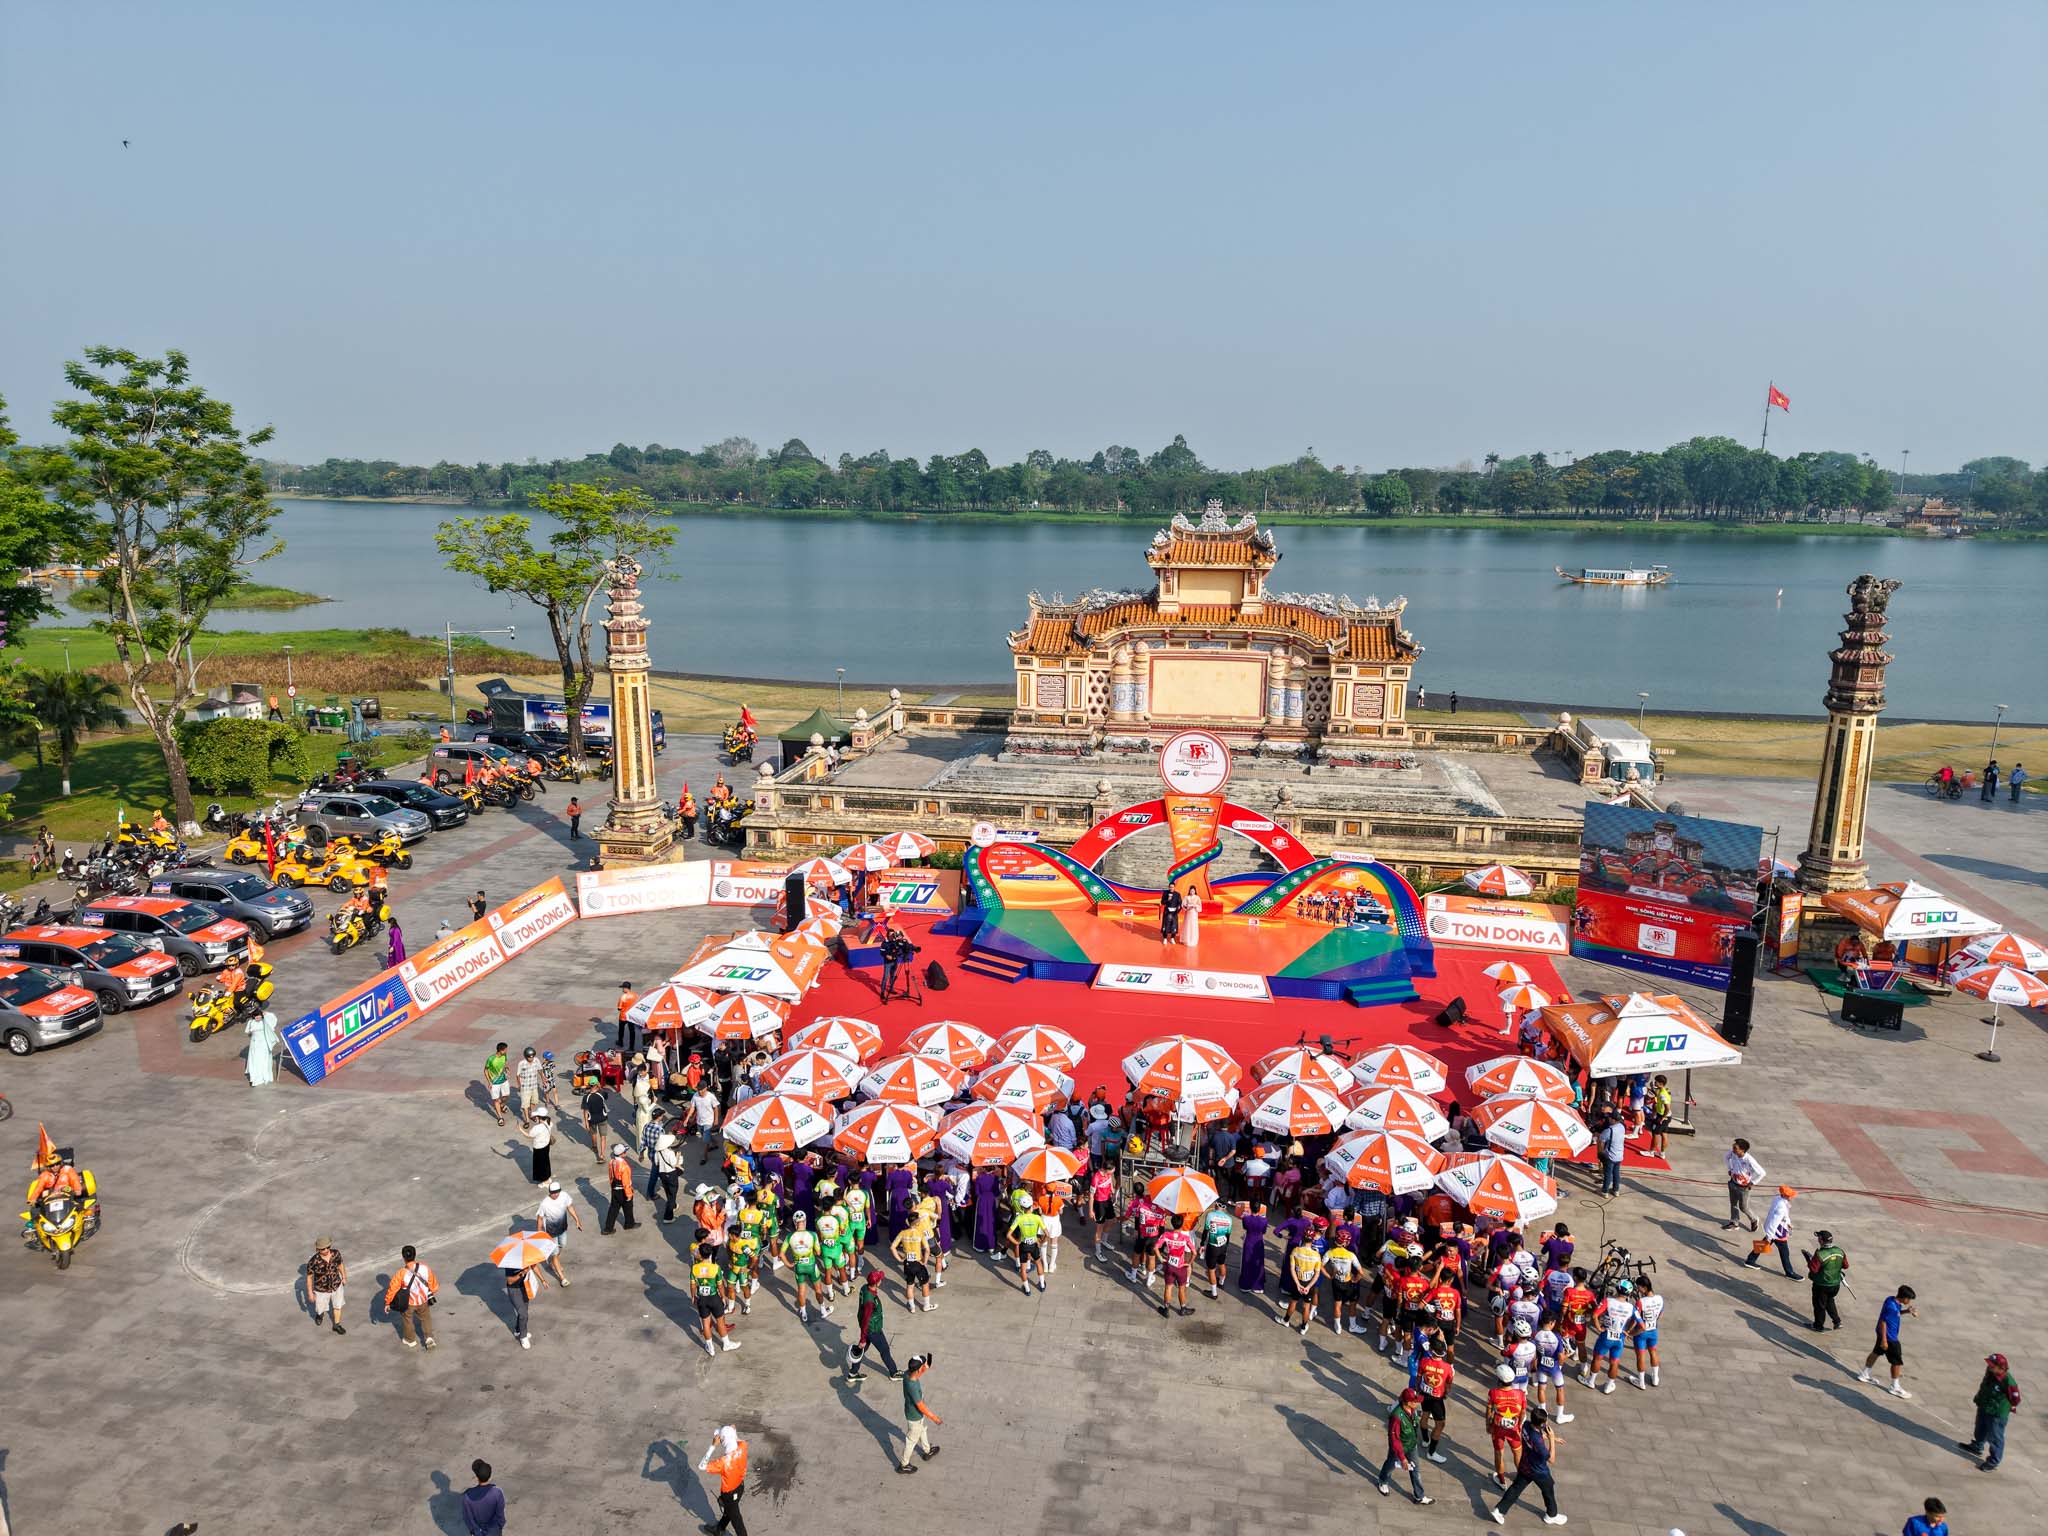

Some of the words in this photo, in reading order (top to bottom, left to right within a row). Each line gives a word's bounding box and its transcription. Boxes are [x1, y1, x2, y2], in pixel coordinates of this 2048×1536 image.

[1119, 813, 1152, 824] HTV
[734, 887, 766, 900] TON
[514, 921, 538, 942] TON
[536, 907, 564, 931] DONG
[561, 902, 572, 914] A
[1911, 912, 1958, 924] HTV
[1452, 922, 1488, 939] TON
[1492, 927, 1544, 944] DONG
[1550, 932, 1562, 946] A
[430, 970, 457, 994] TON
[456, 952, 489, 979] DONG
[489, 947, 500, 961] A
[709, 965, 772, 981] HTV
[1116, 972, 1152, 984] HTV
[327, 994, 375, 1047] HTV
[1626, 1034, 1688, 1054] HTV
[784, 1076, 808, 1086] HTV
[1186, 1071, 1209, 1081] HTV
[920, 1079, 940, 1090] HTV
[1003, 1089, 1027, 1097] HTV
[1262, 1105, 1287, 1116] HTV
[1358, 1108, 1382, 1120] HTV
[1498, 1121, 1525, 1134] HTV
[874, 1136, 900, 1144] HTV
[1395, 1163, 1417, 1174] HTV
[1359, 1180, 1380, 1188] HTV
[1519, 1188, 1538, 1200] HTV
[1482, 1208, 1504, 1217] HTV
